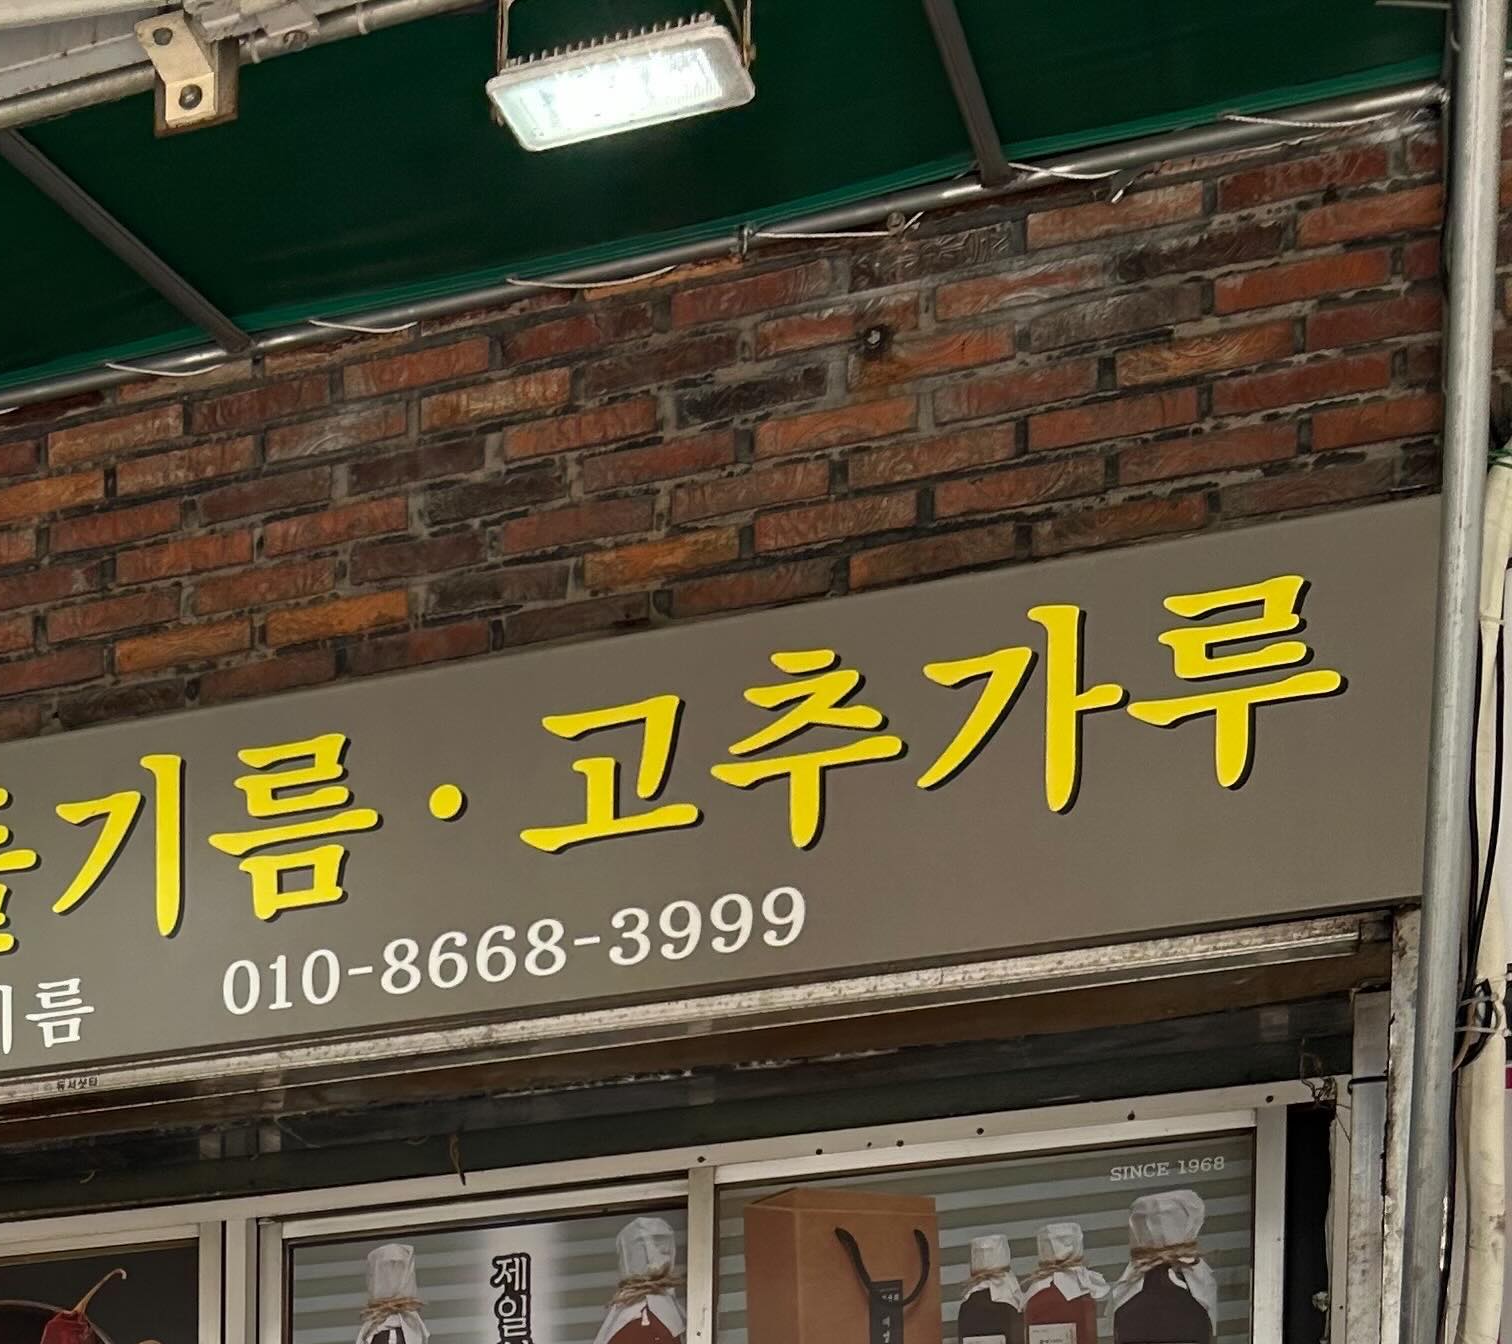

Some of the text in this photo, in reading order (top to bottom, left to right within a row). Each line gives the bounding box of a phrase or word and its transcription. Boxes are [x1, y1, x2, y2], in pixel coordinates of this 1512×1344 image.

[519, 574, 1348, 854] 고추가루
[221, 886, 808, 1018] 010-8668-3999
[1110, 1156, 1225, 1182] SINCE 1968
